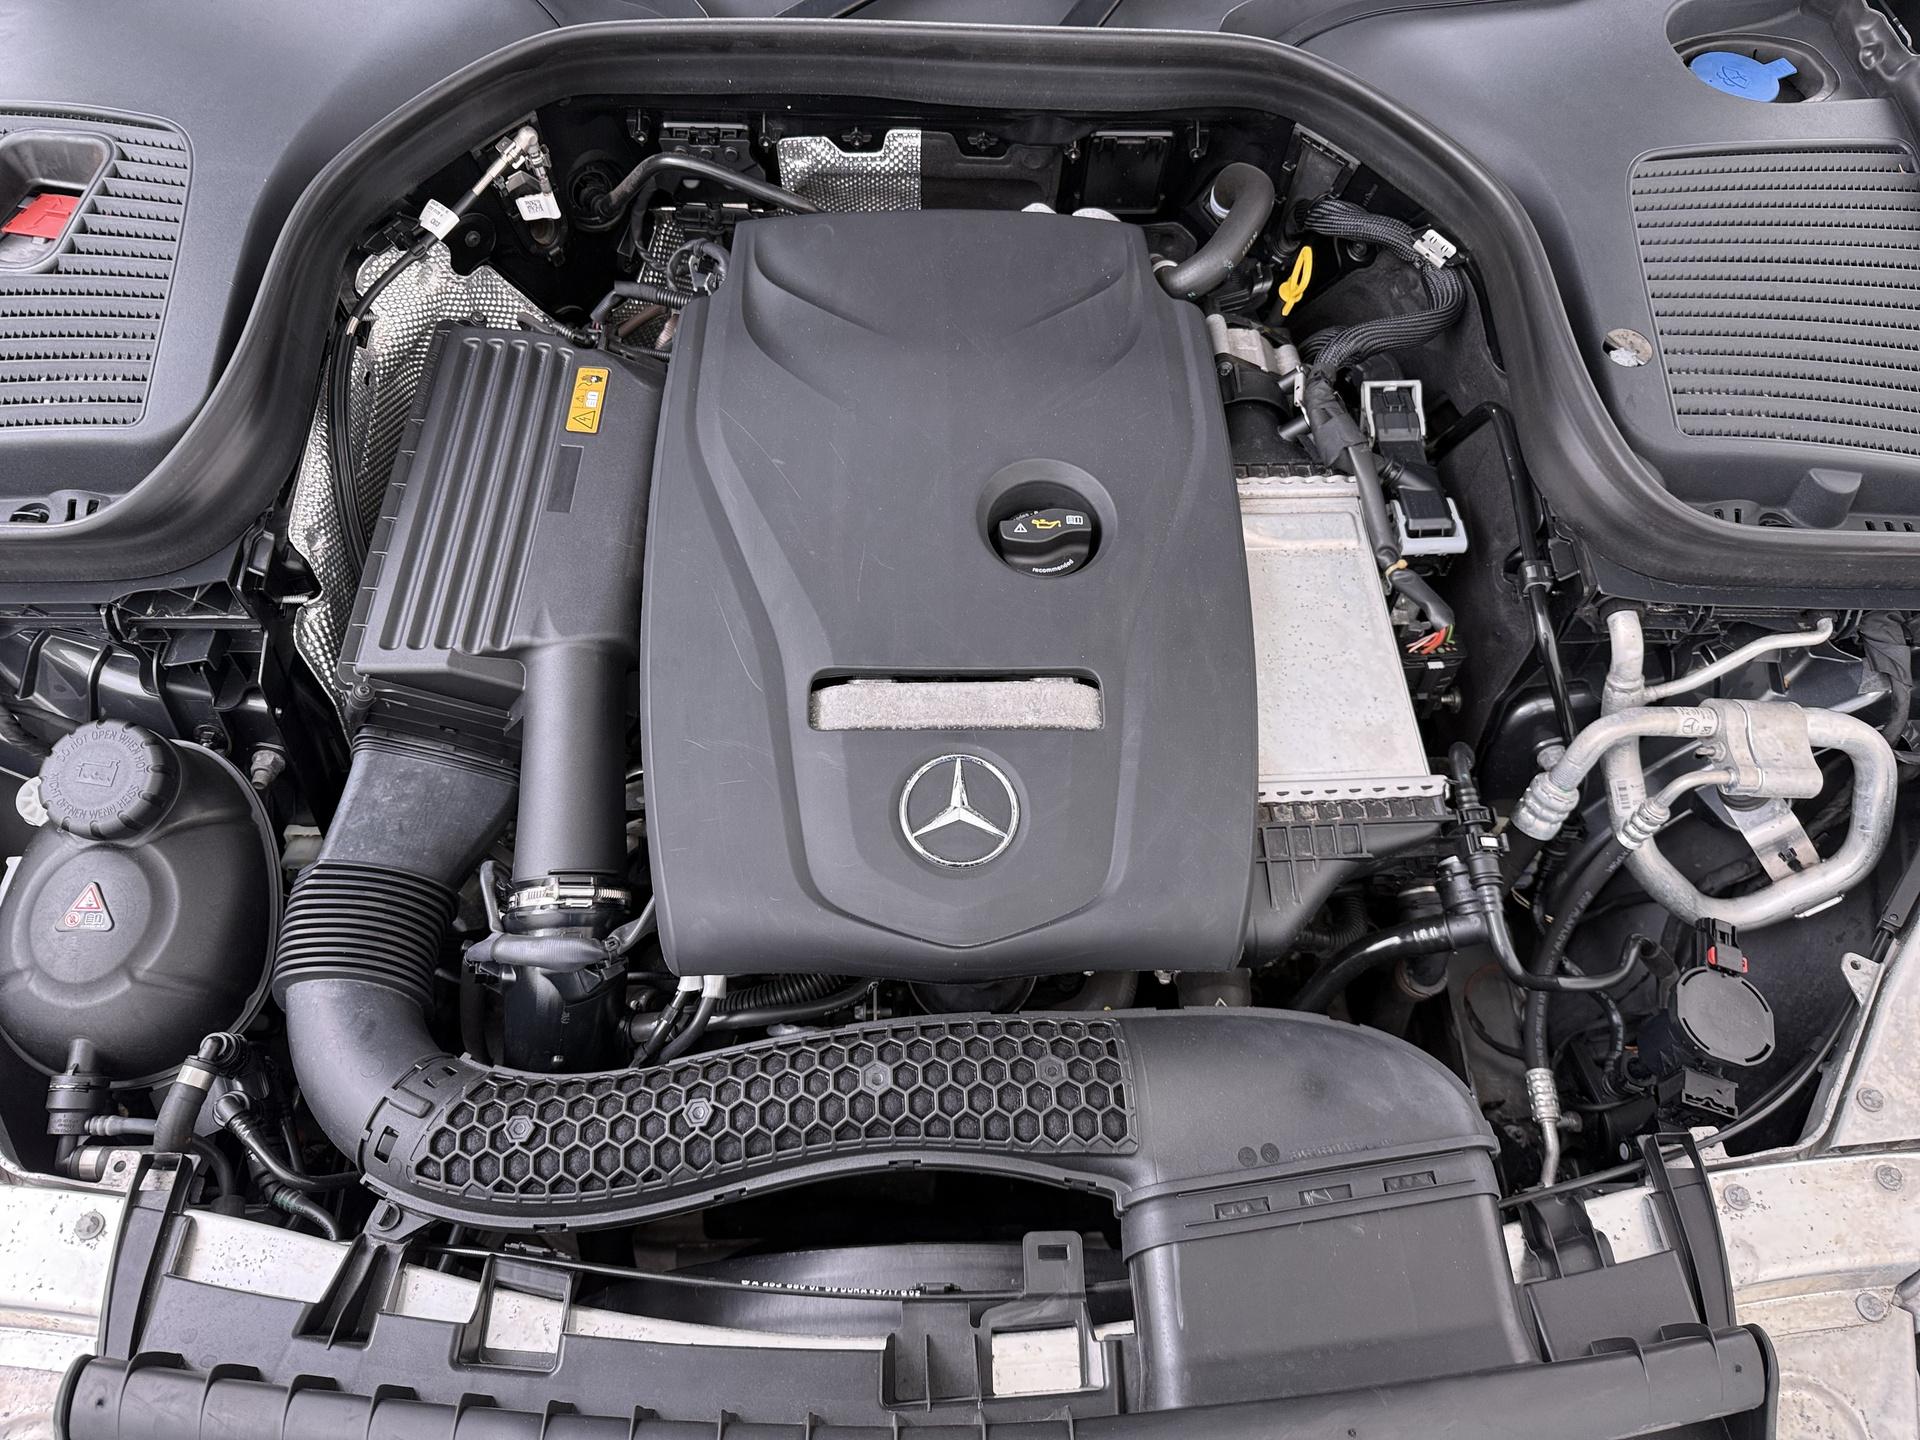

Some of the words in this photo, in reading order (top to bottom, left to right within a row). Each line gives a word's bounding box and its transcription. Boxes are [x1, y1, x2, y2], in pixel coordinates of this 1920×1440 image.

[1032, 558, 1074, 574] recommended
[55, 748, 71, 763] DO
[71, 734, 89, 752] NOT
[91, 729, 117, 741] OPEN
[119, 732, 141, 757] WHEN
[134, 754, 146, 774] HOT
[89, 804, 117, 819] WENN
[119, 783, 140, 809] HEISS
